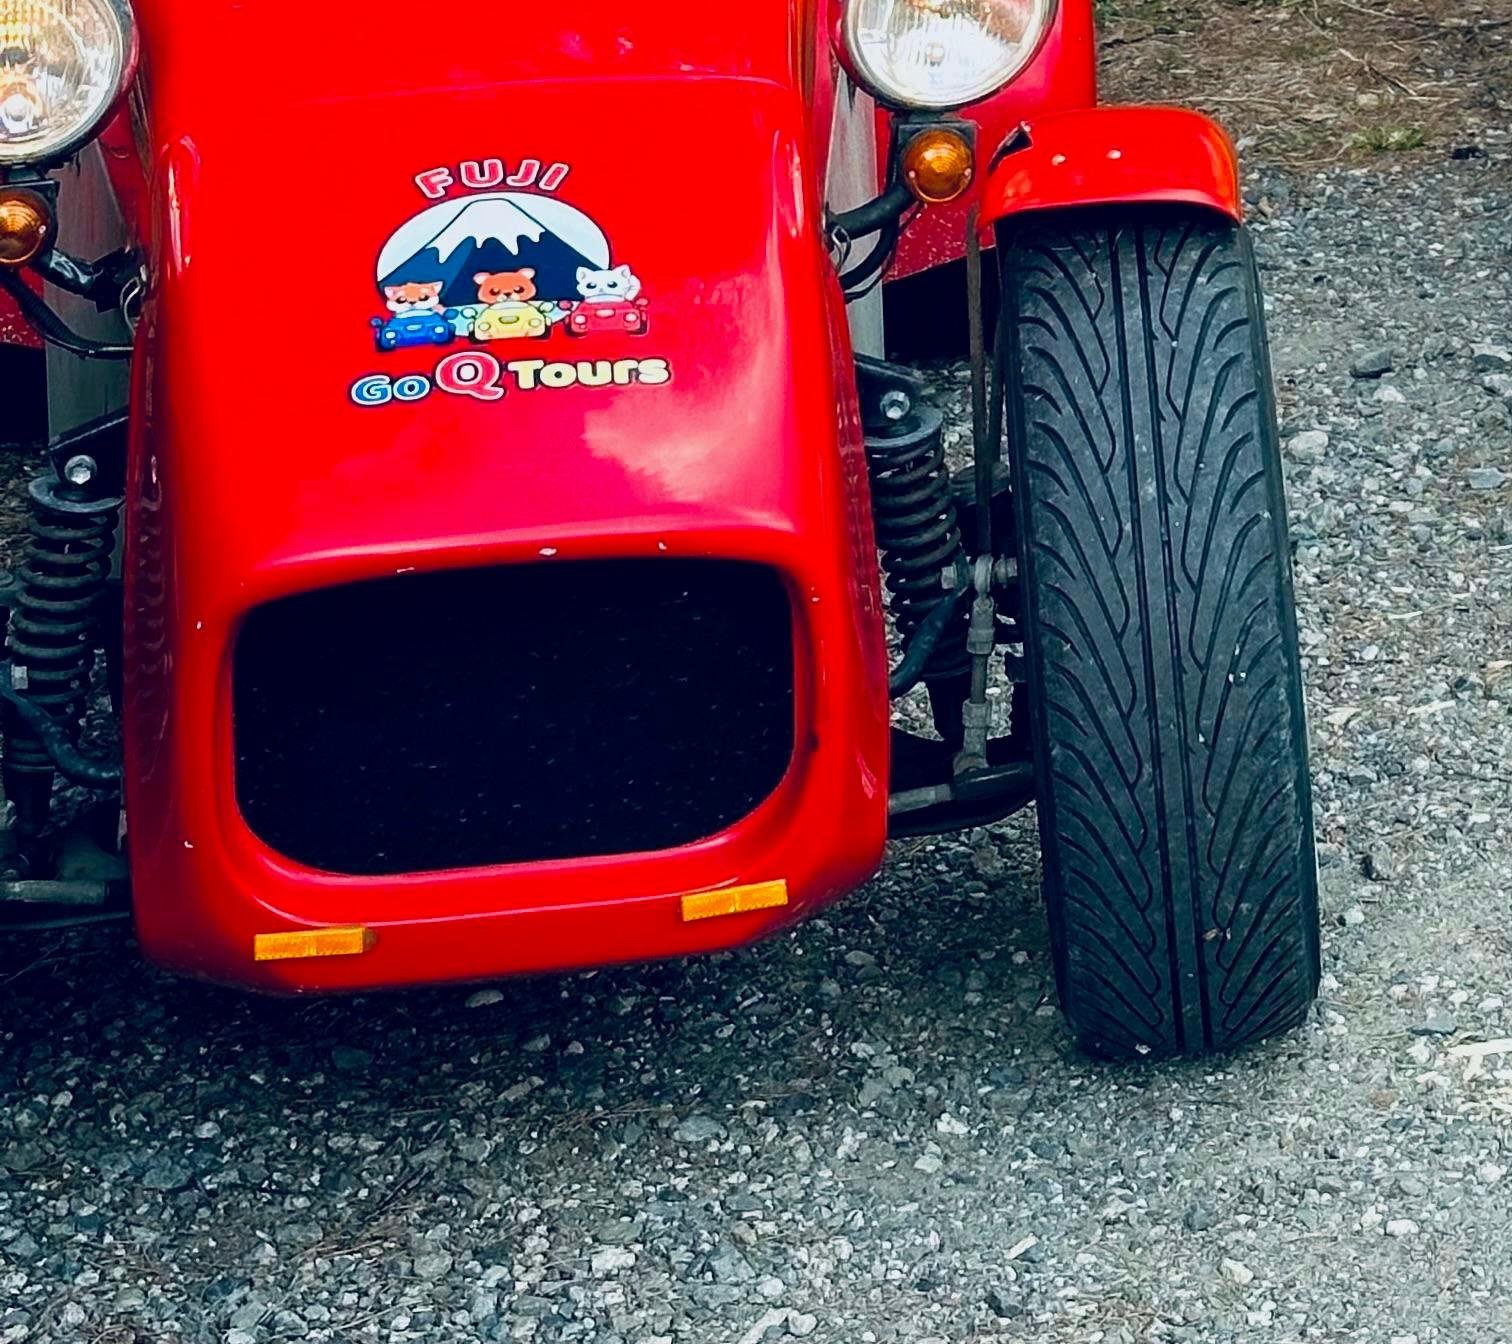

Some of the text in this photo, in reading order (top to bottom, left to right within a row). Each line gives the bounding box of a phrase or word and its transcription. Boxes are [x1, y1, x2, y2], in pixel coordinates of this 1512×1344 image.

[414, 158, 570, 198] FUJI
[435, 351, 505, 400] Q
[507, 358, 671, 390] Tours
